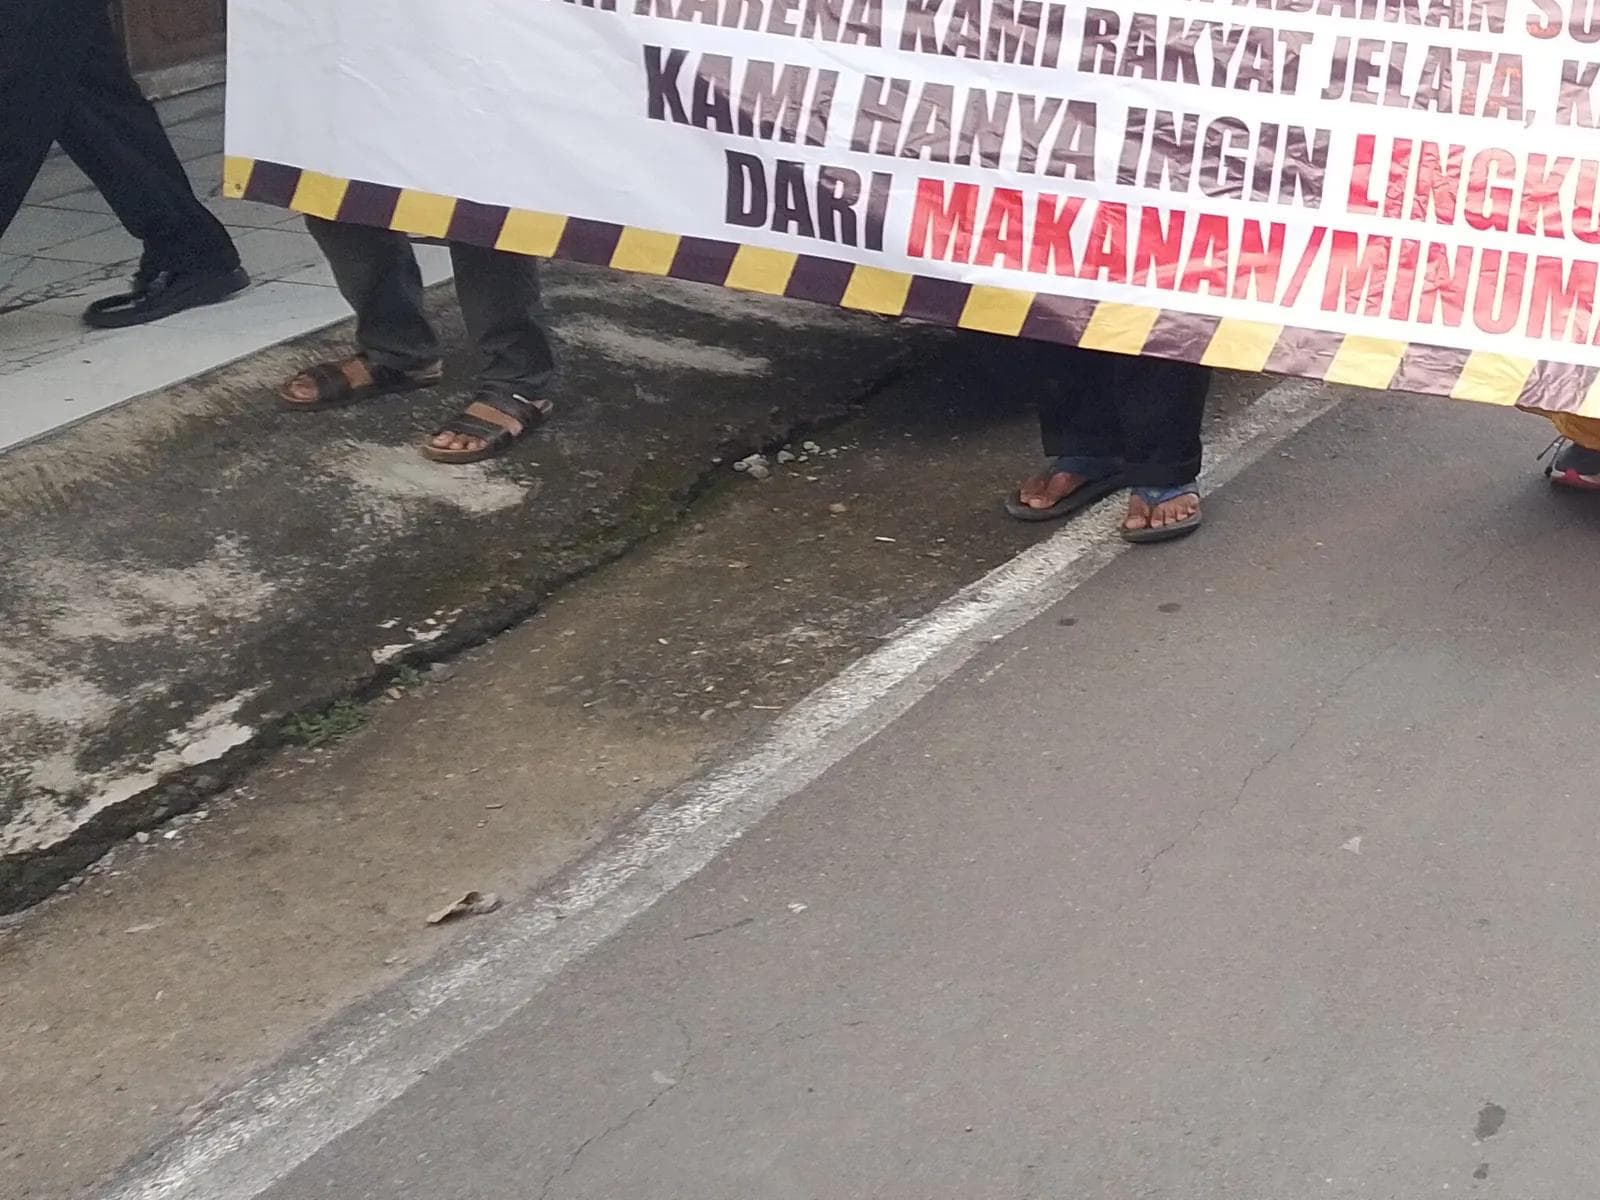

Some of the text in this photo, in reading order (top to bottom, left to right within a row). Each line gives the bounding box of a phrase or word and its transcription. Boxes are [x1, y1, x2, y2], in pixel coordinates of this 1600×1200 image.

[643, 45, 840, 150] KAMI
[850, 77, 1098, 182] HANYA
[1118, 105, 1331, 212] INGIN
[1079, 7, 1313, 96] RAKYAT
[1321, 36, 1536, 130] JELATA,
[725, 149, 894, 253] DARI
